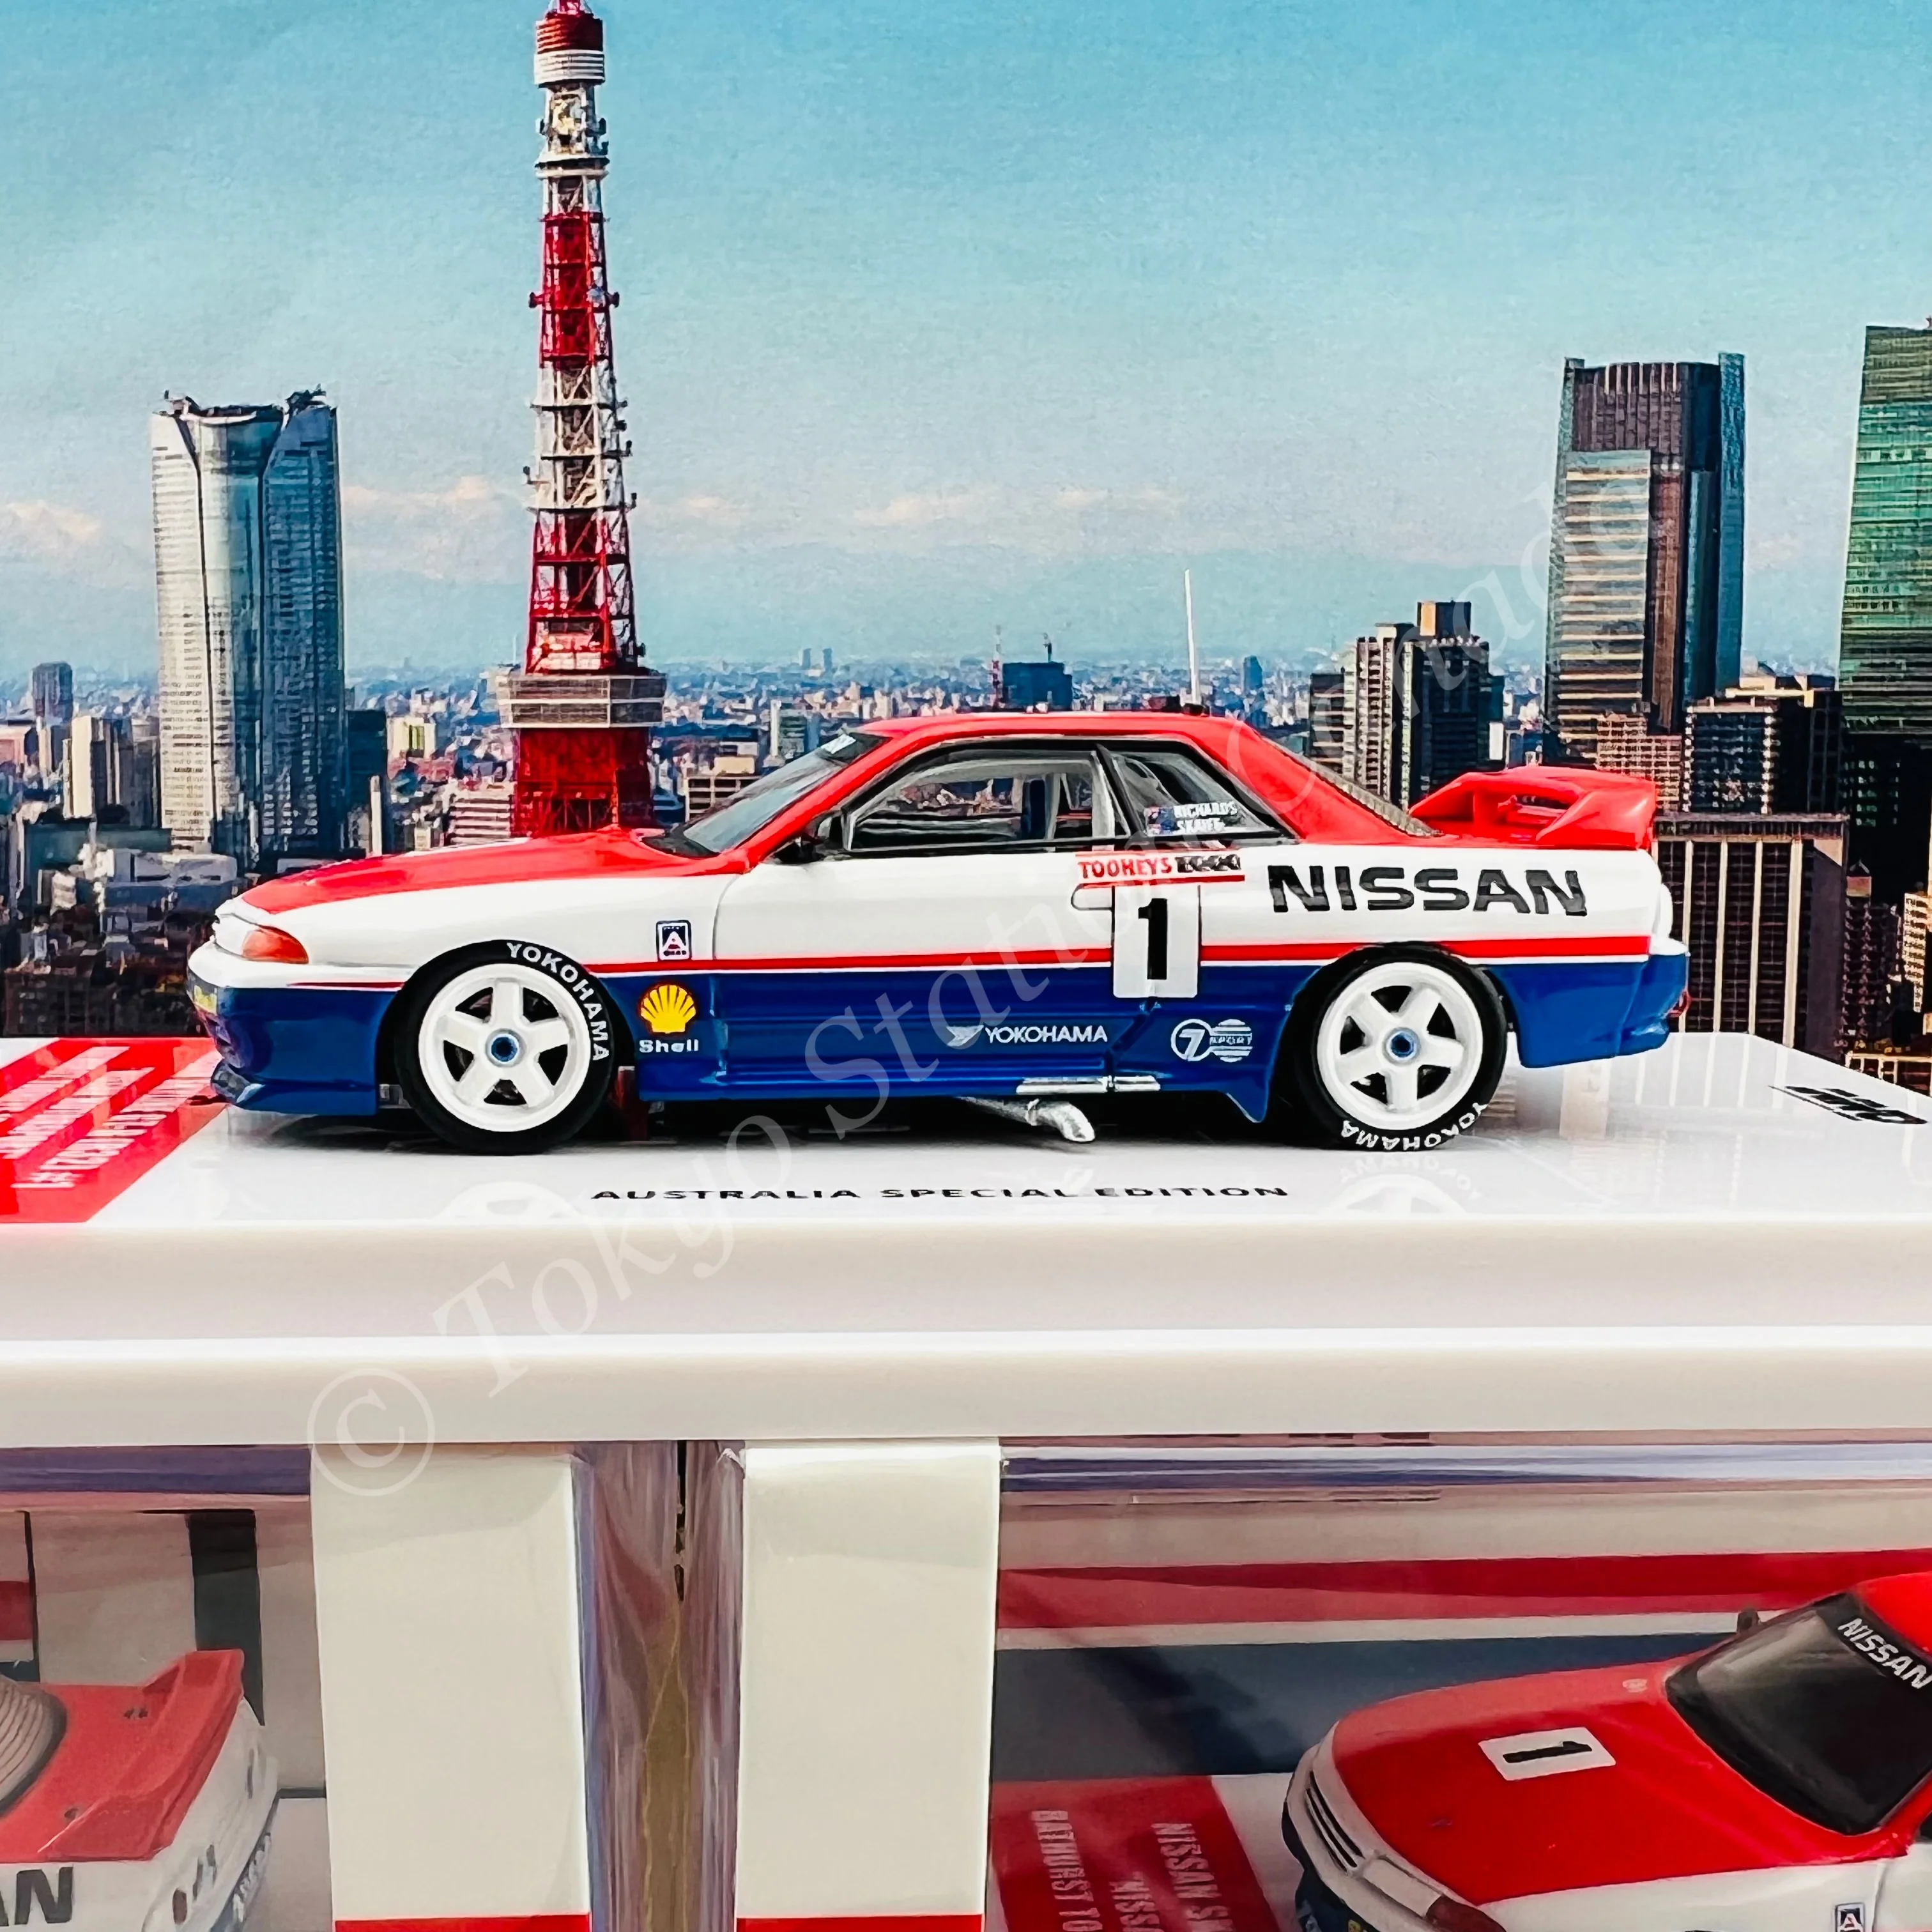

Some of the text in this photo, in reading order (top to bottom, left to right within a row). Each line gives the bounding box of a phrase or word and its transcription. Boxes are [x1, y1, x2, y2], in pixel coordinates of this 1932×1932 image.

[1078, 857, 1172, 878] TOOHEYS
[1268, 865, 1587, 916] NISSAN
[1138, 898, 1168, 980] 1
[506, 942, 610, 1061] YOKOHAMA
[639, 1039, 699, 1054] Shell
[985, 1025, 1108, 1043] YOKOHAMA
[1341, 1102, 1489, 1151] YOKOHAMA
[590, 1188, 1289, 1199] AUSTRALIA SPECIAL EDITION
[1837, 1618, 1932, 1689] NISSAN
[1503, 1740, 1593, 1763] 1
[1151, 1823, 1223, 1899] NISSAN
